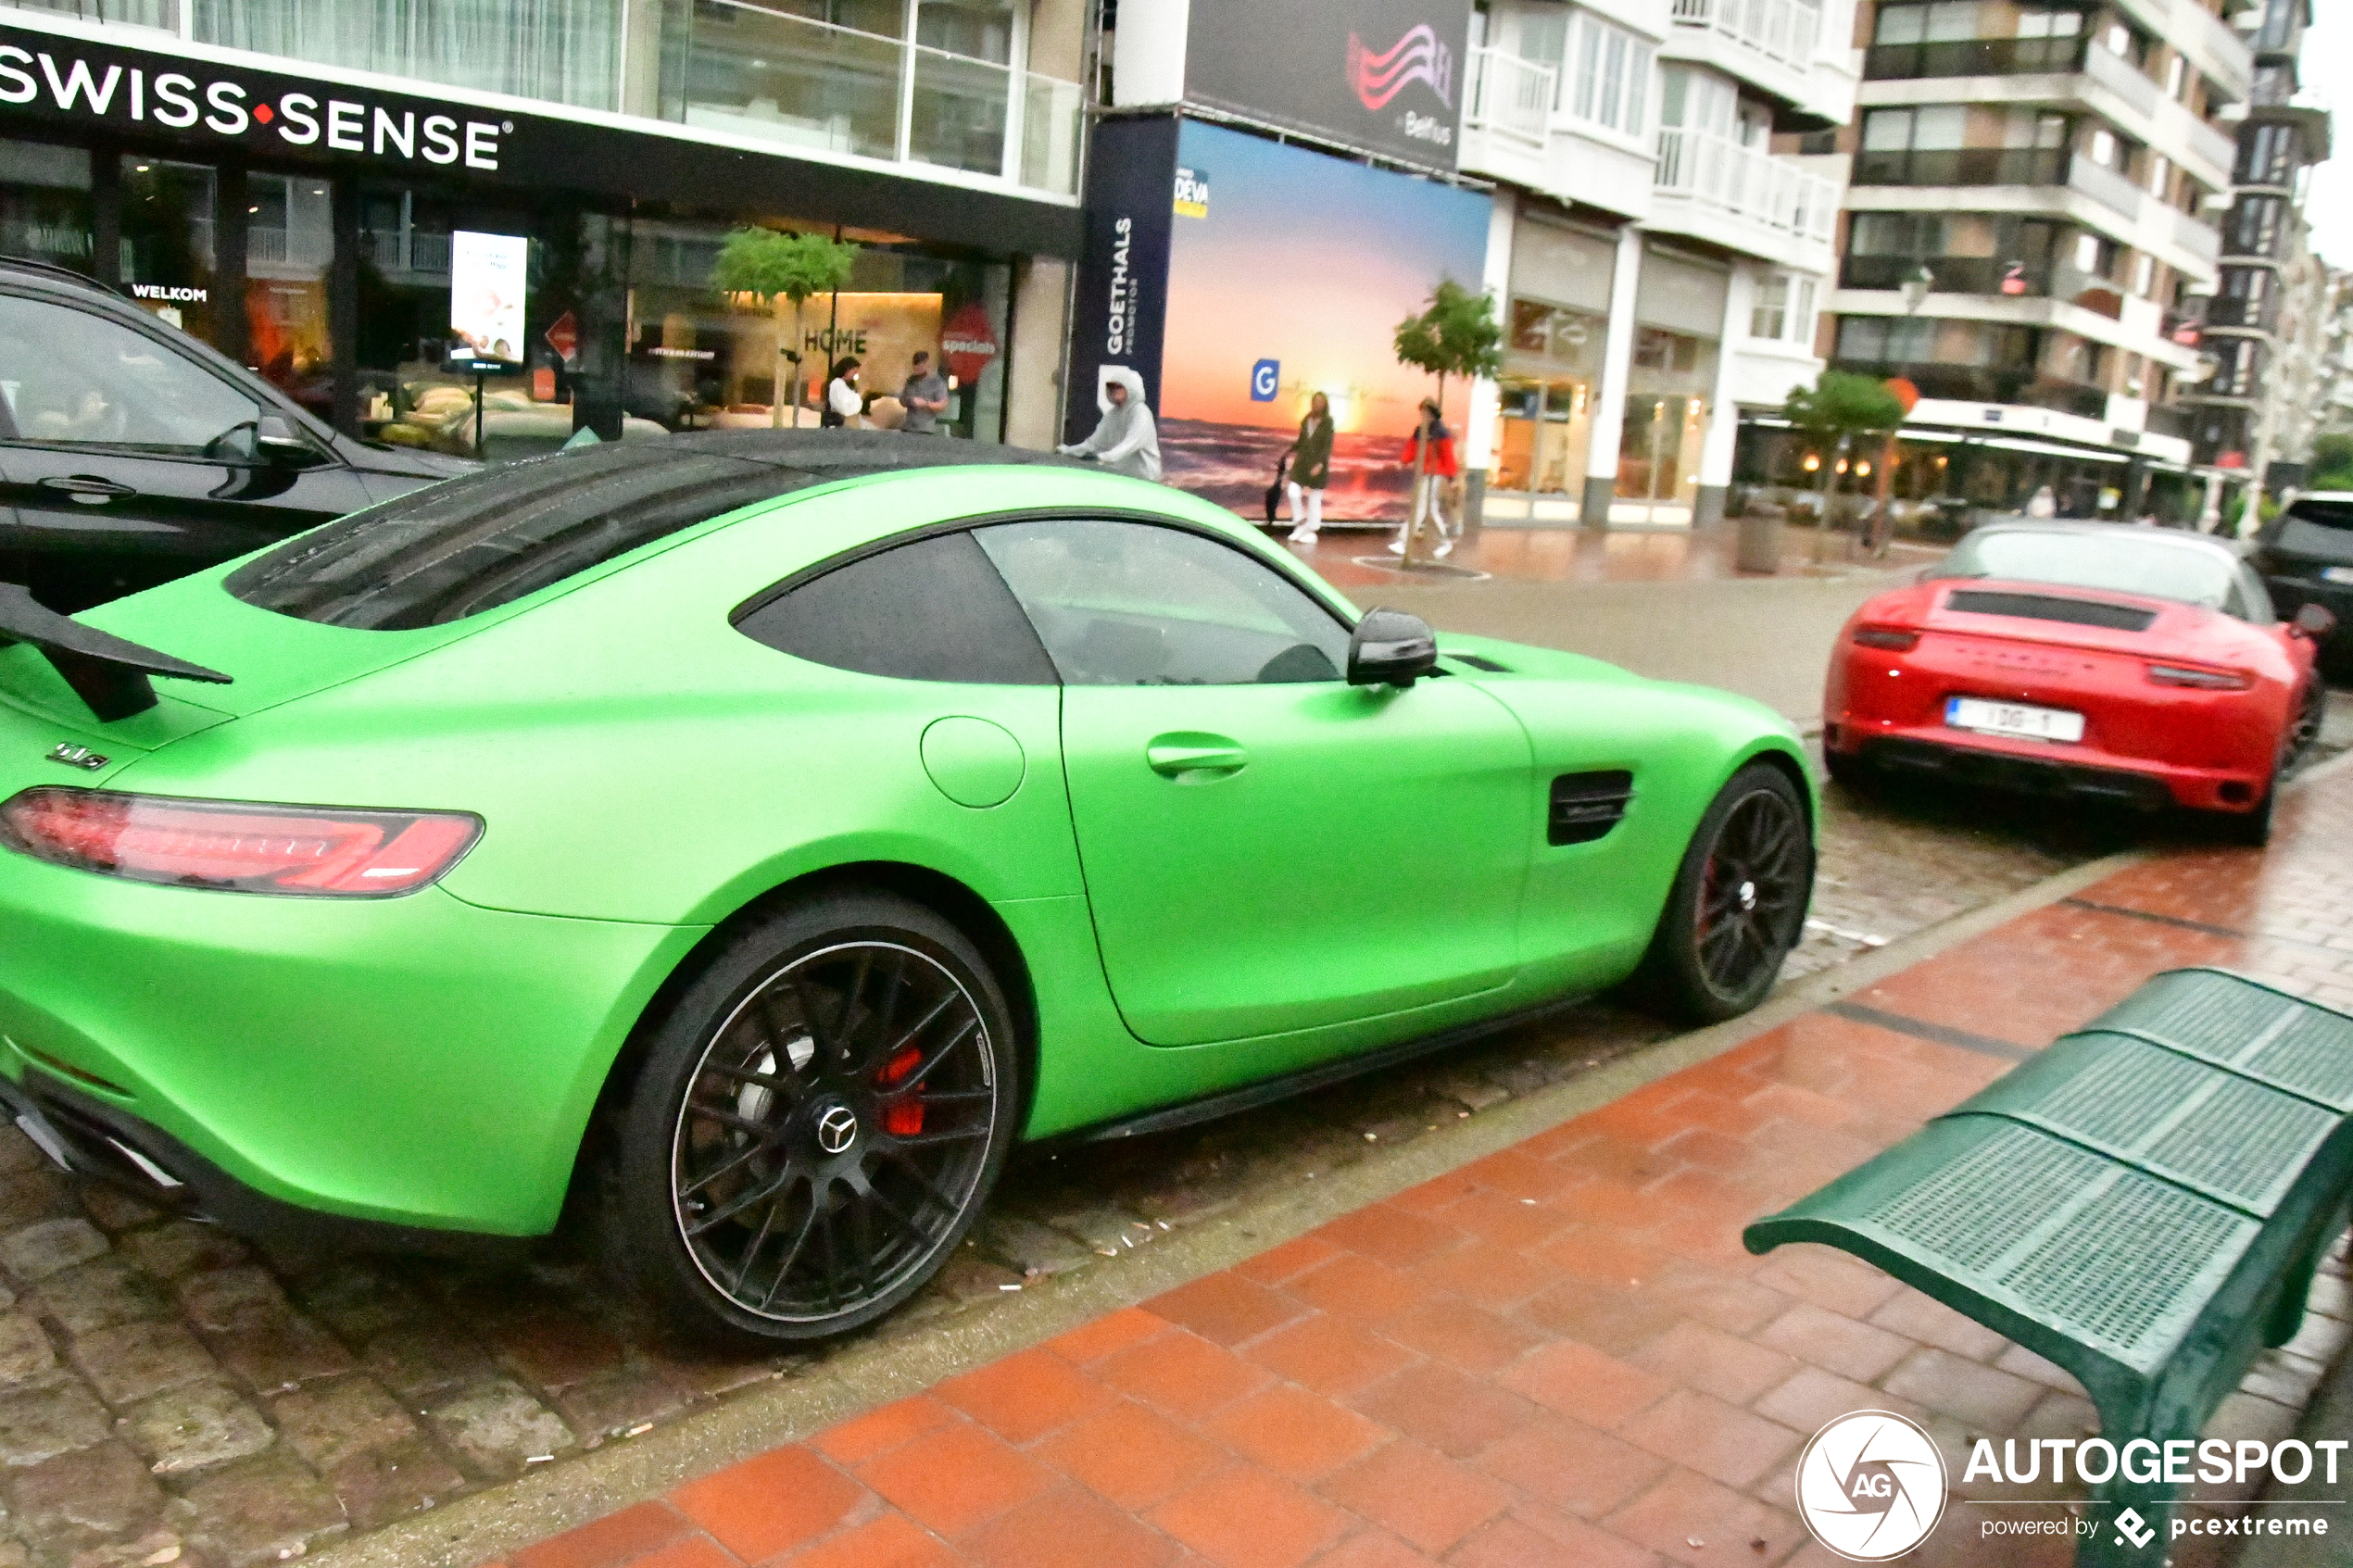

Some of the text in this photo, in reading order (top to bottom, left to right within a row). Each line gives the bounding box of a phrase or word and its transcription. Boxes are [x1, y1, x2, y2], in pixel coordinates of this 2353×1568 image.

[0, 44, 250, 135] SWISS
[1174, 177, 1208, 205] DEVA
[132, 283, 208, 303] WELKOM
[1107, 217, 1132, 356] GOETHALS
[804, 328, 867, 354] HOME
